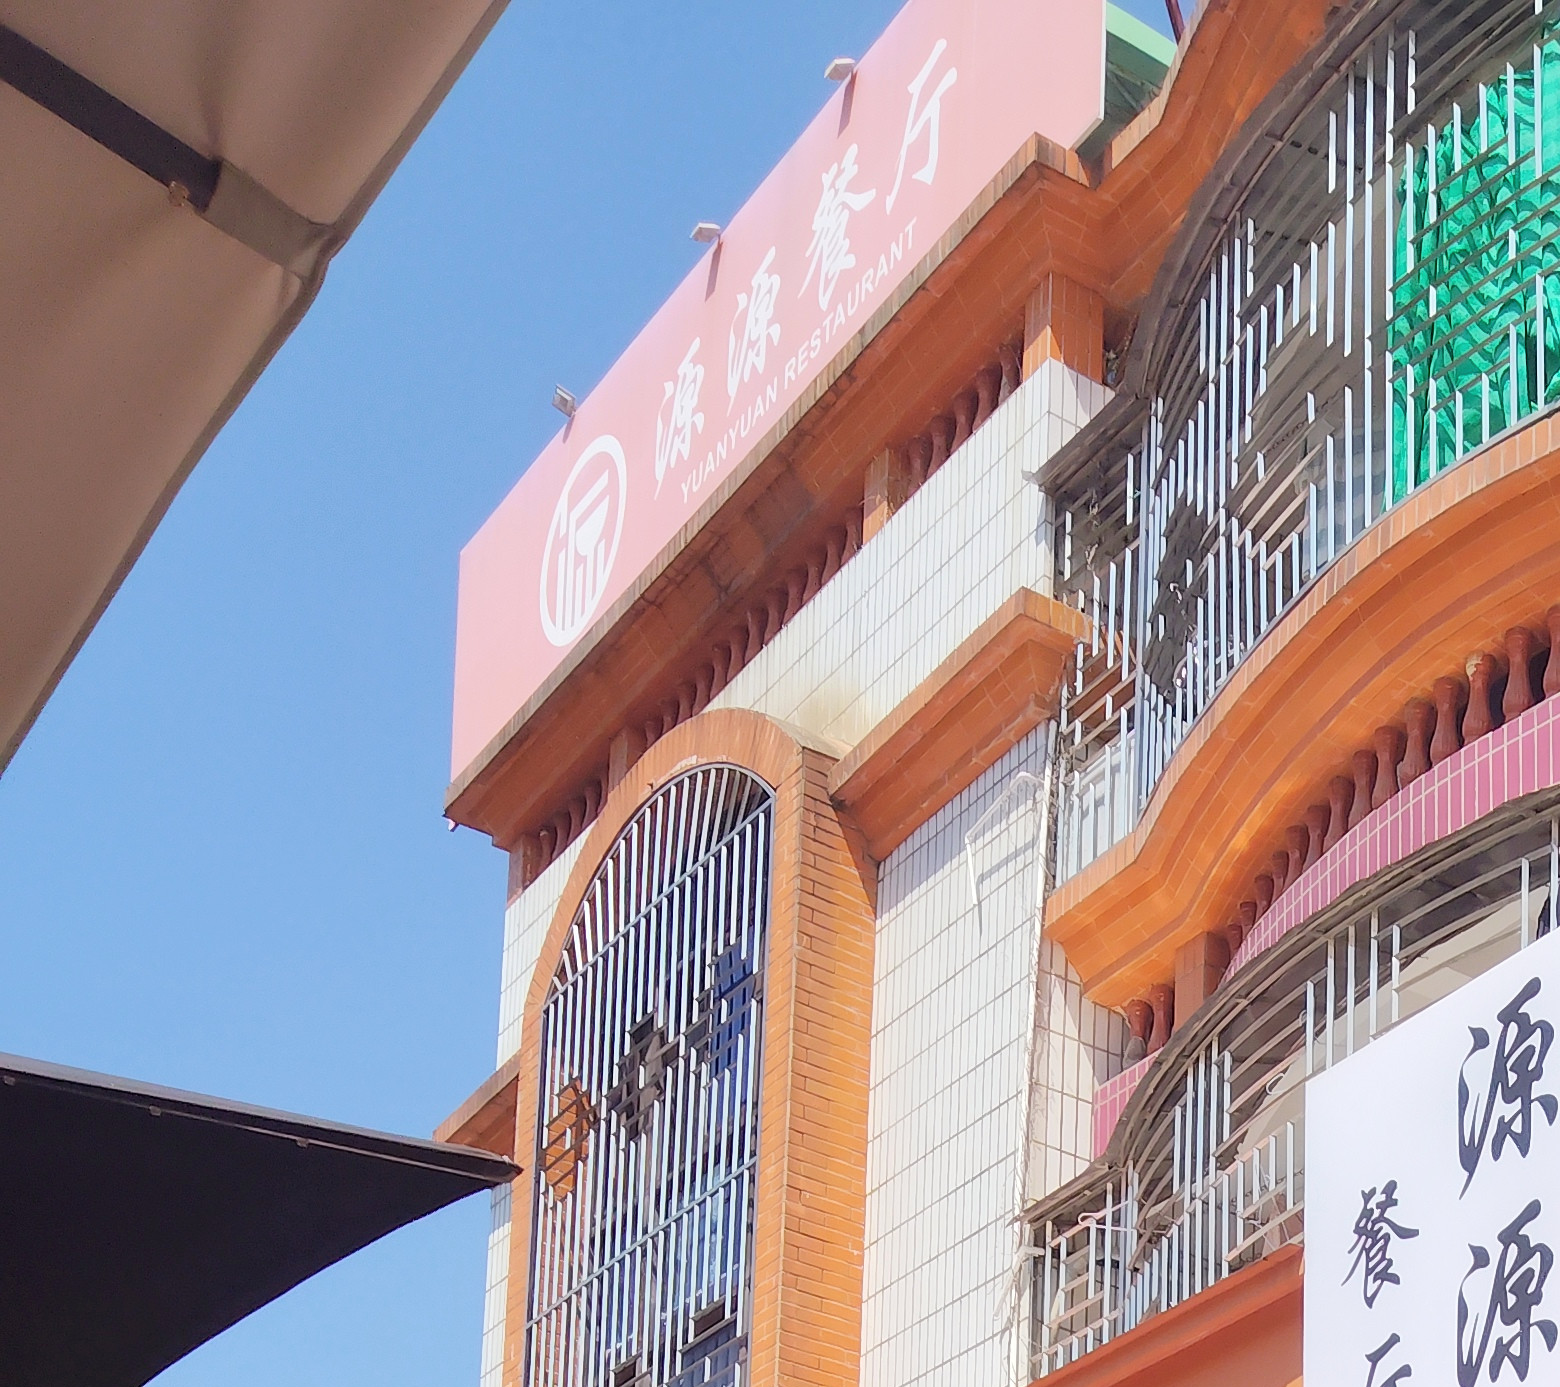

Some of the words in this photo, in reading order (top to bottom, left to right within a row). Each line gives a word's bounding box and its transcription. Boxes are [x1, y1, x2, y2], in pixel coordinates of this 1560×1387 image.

[654, 38, 958, 500] 源源餐厅
[681, 377, 778, 504] YUANYUAN
[784, 218, 917, 390] RESTAURANT
